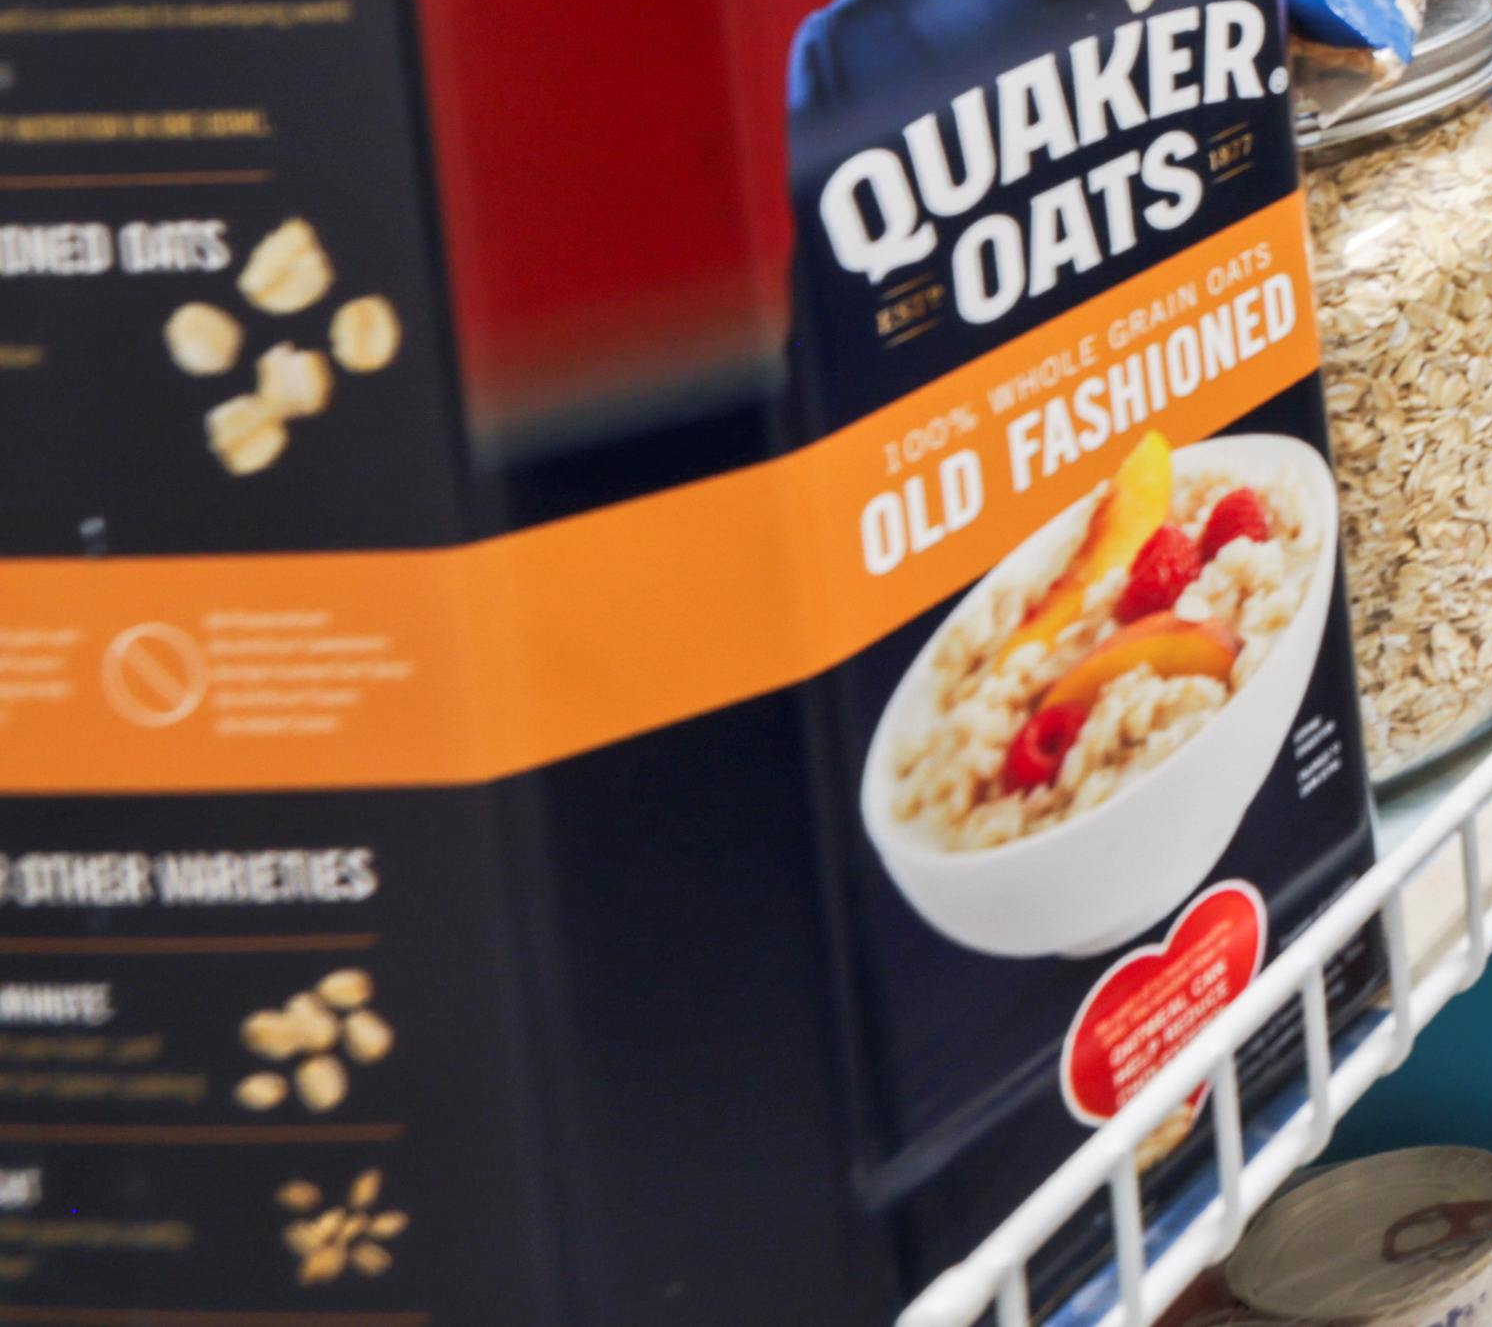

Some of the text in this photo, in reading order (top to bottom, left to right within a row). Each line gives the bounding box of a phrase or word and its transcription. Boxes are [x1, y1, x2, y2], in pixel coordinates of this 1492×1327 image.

[950, 129, 1203, 326] OATS
[859, 272, 1298, 577] OLD FASHIONED
[883, 241, 1273, 478] 100% WHOLE GRAIN OATS
